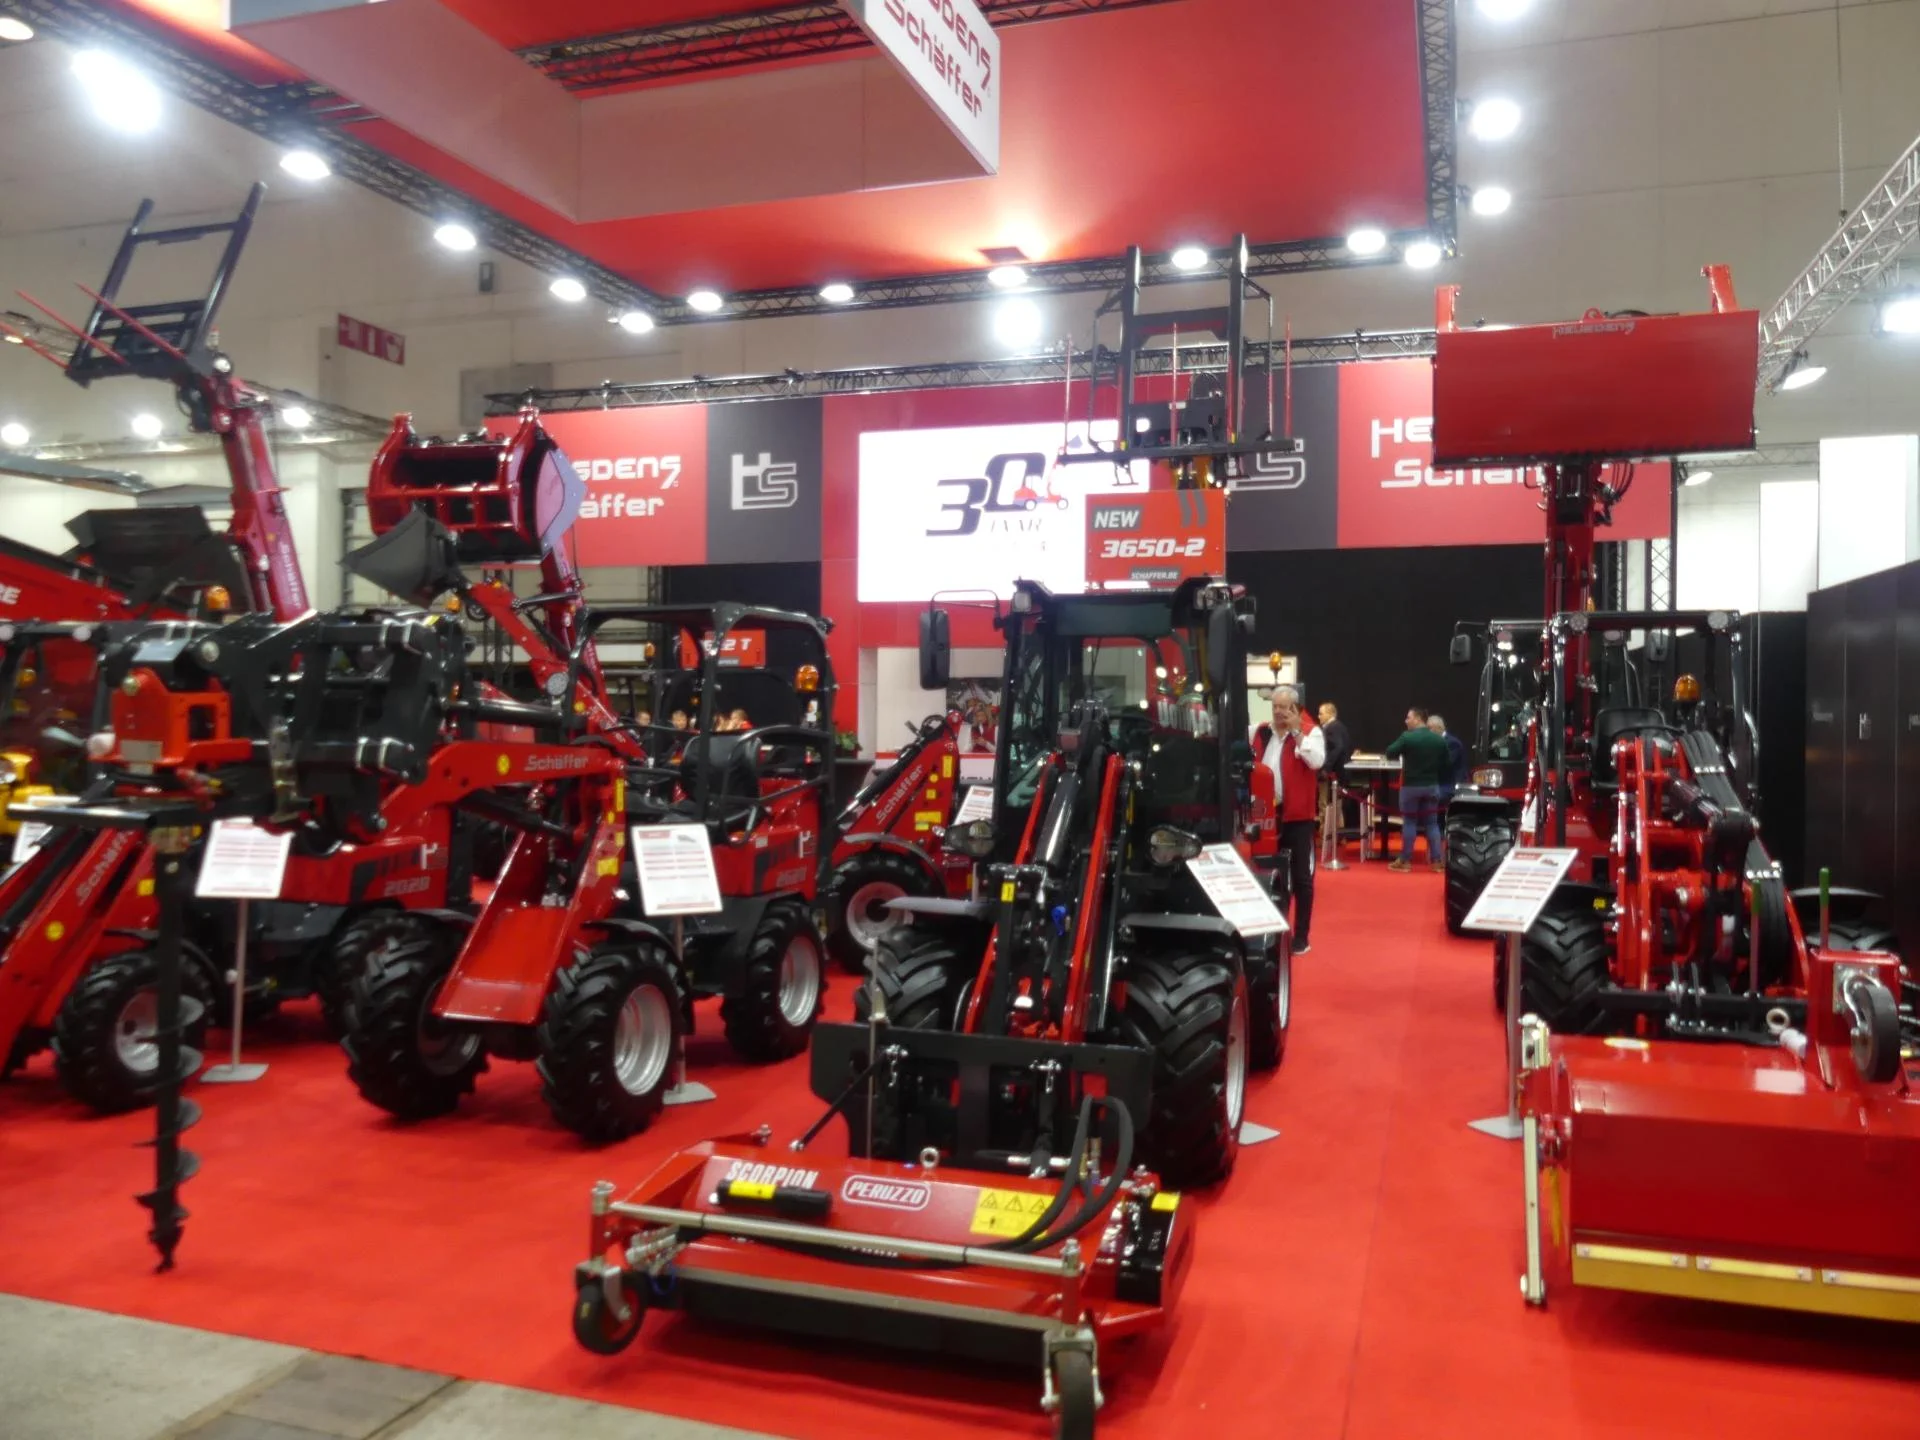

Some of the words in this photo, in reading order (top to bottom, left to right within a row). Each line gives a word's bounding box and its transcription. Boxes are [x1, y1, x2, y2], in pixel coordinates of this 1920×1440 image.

[925, 452, 1047, 537] 30
[1094, 510, 1140, 529] NEW
[1100, 537, 1206, 559] 3650-2
[524, 753, 589, 772] Schäffer
[875, 764, 923, 825] Schäffer
[726, 1160, 819, 1189] SCORPION
[847, 1180, 926, 1205] PERUZZO
